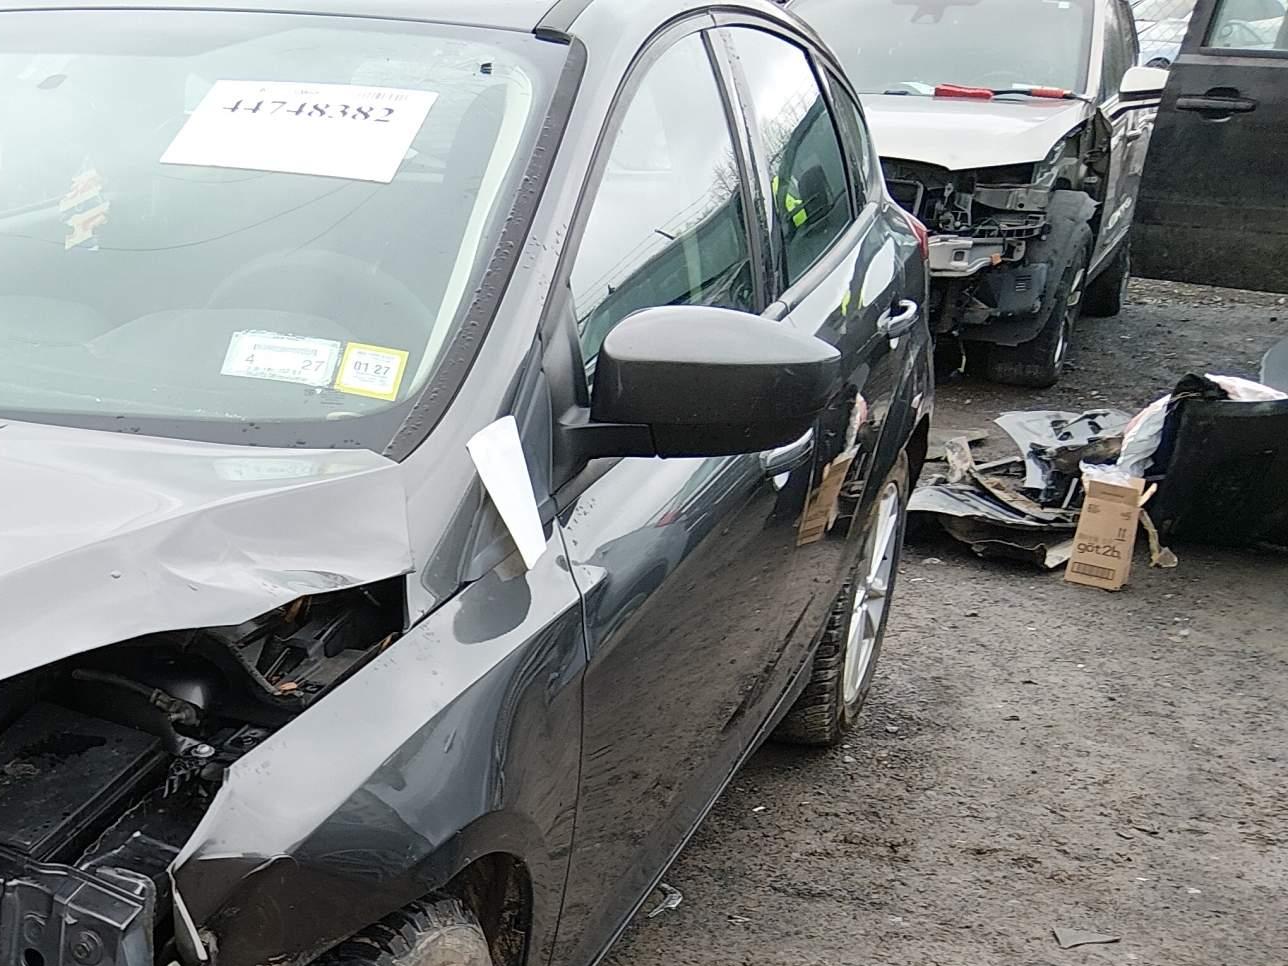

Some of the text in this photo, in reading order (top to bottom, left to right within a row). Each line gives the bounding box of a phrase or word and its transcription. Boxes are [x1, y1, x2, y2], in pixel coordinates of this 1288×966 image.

[223, 99, 395, 122] 44748382
[301, 359, 325, 372] 27
[353, 360, 391, 376] 01 27
